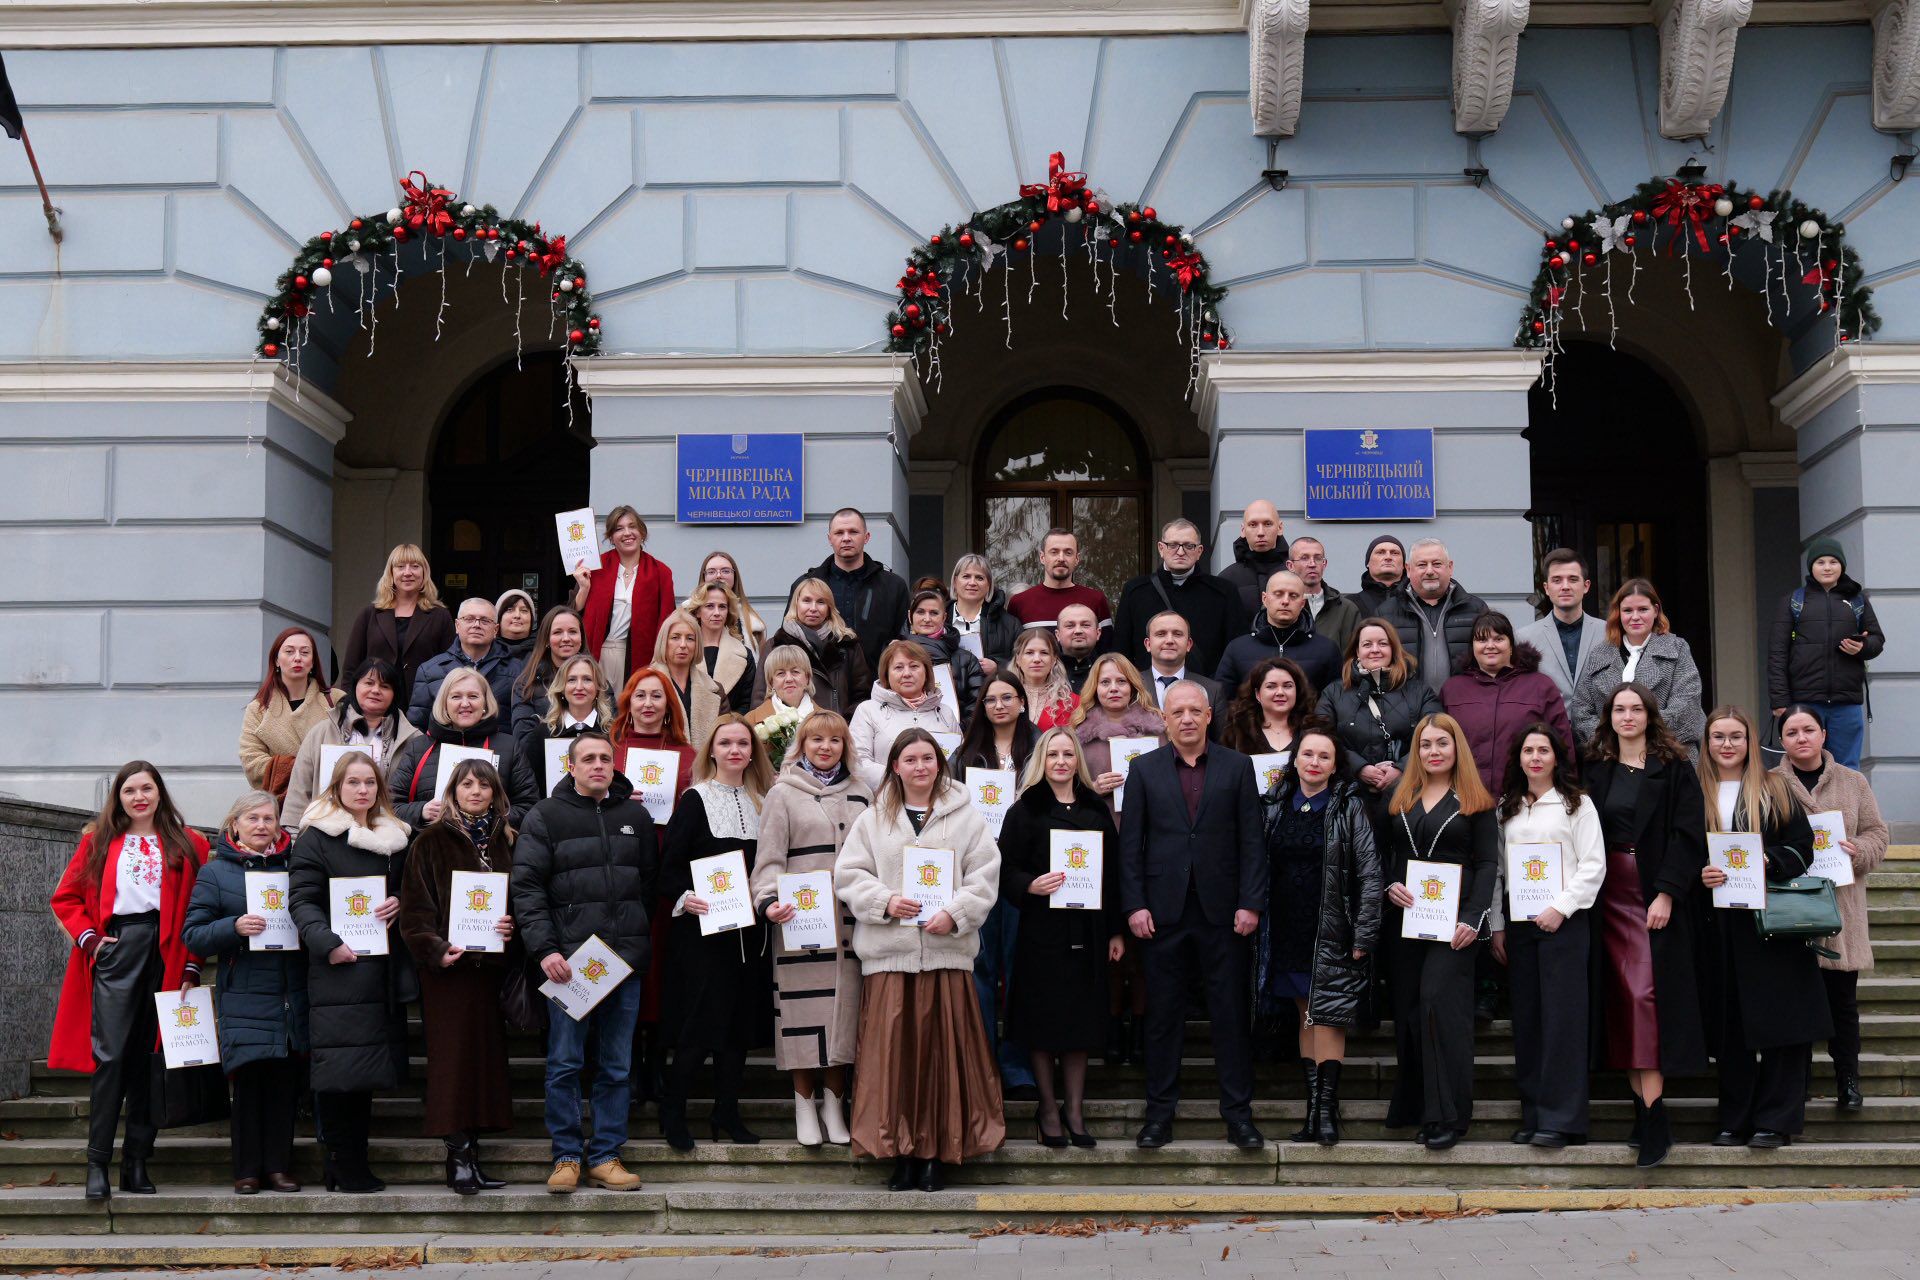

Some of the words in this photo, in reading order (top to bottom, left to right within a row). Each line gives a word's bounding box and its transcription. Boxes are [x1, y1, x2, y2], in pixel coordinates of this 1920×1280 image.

[686, 468, 794, 484] ЧЕРНІВЕЦЬКА
[1316, 460, 1424, 480] ЧЕРНІВЕЦЬКИЙ
[688, 486, 746, 500] МІСЬКА
[752, 486, 791, 502] РАДА
[1309, 482, 1371, 500] МІСЬКИЙ
[1377, 484, 1431, 500] ГОЛОВА
[687, 510, 751, 518] ЧЕРНІВЕЦЬКОЇ
[754, 510, 792, 518] ОБЛАСТІ
[644, 797, 666, 806] МОТА
[789, 922, 828, 932] ГРАМОТА
[170, 1038, 210, 1048] ГРАМОТА
